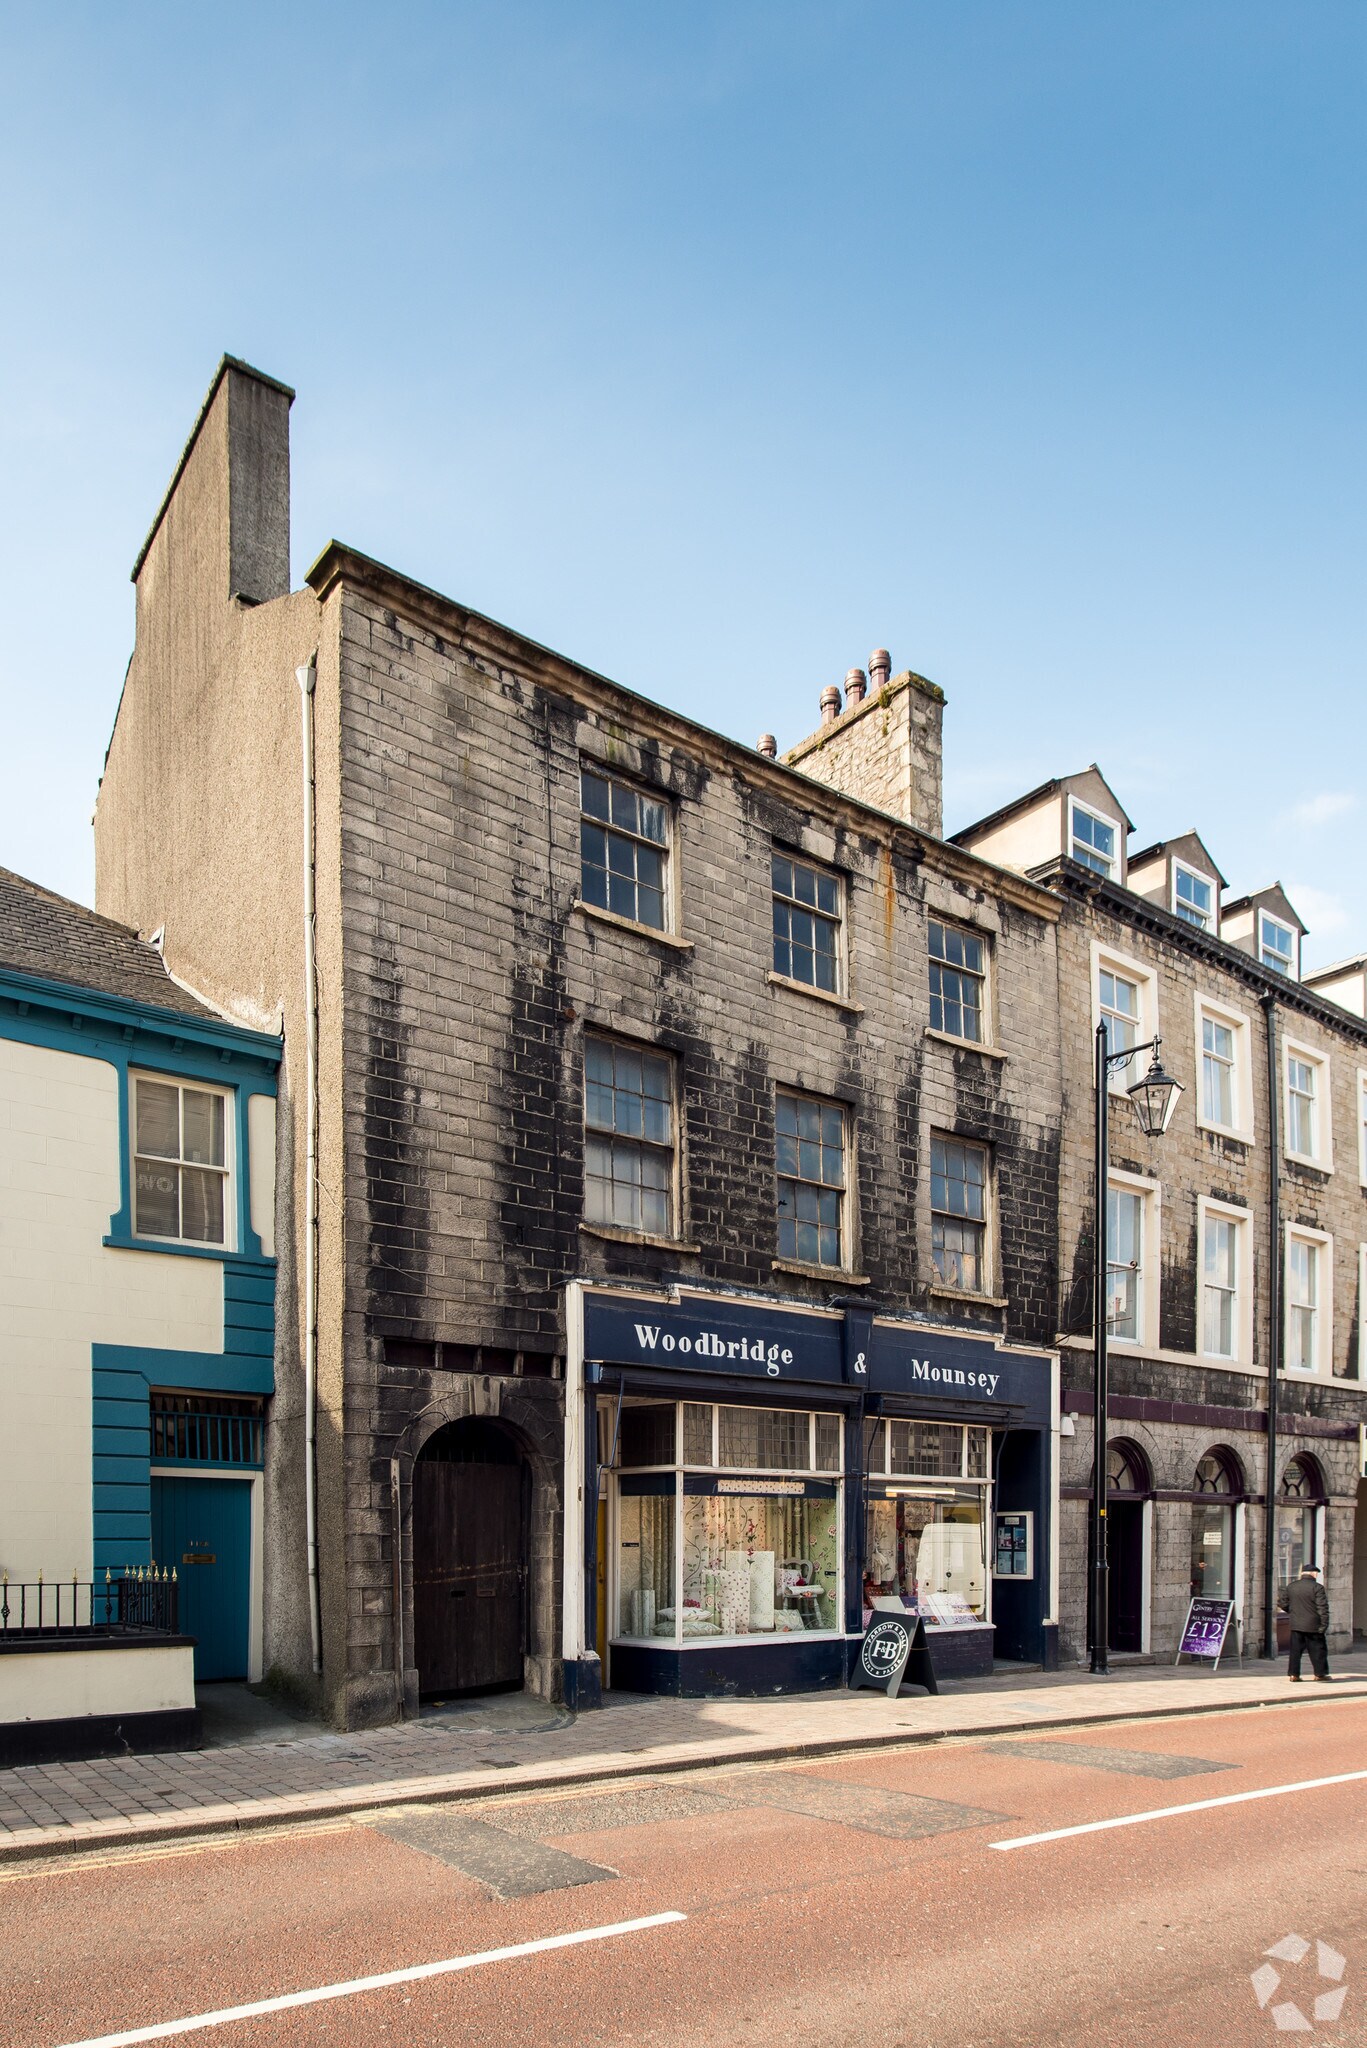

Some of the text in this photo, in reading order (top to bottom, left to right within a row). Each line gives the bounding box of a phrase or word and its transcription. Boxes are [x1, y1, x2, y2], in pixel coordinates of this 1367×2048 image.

[634, 1325, 1001, 1396] Woodbridge & Mounsey
[867, 1624, 894, 1643] FARROW
[898, 1630, 907, 1649] BALL
[871, 1639, 898, 1660] F&B
